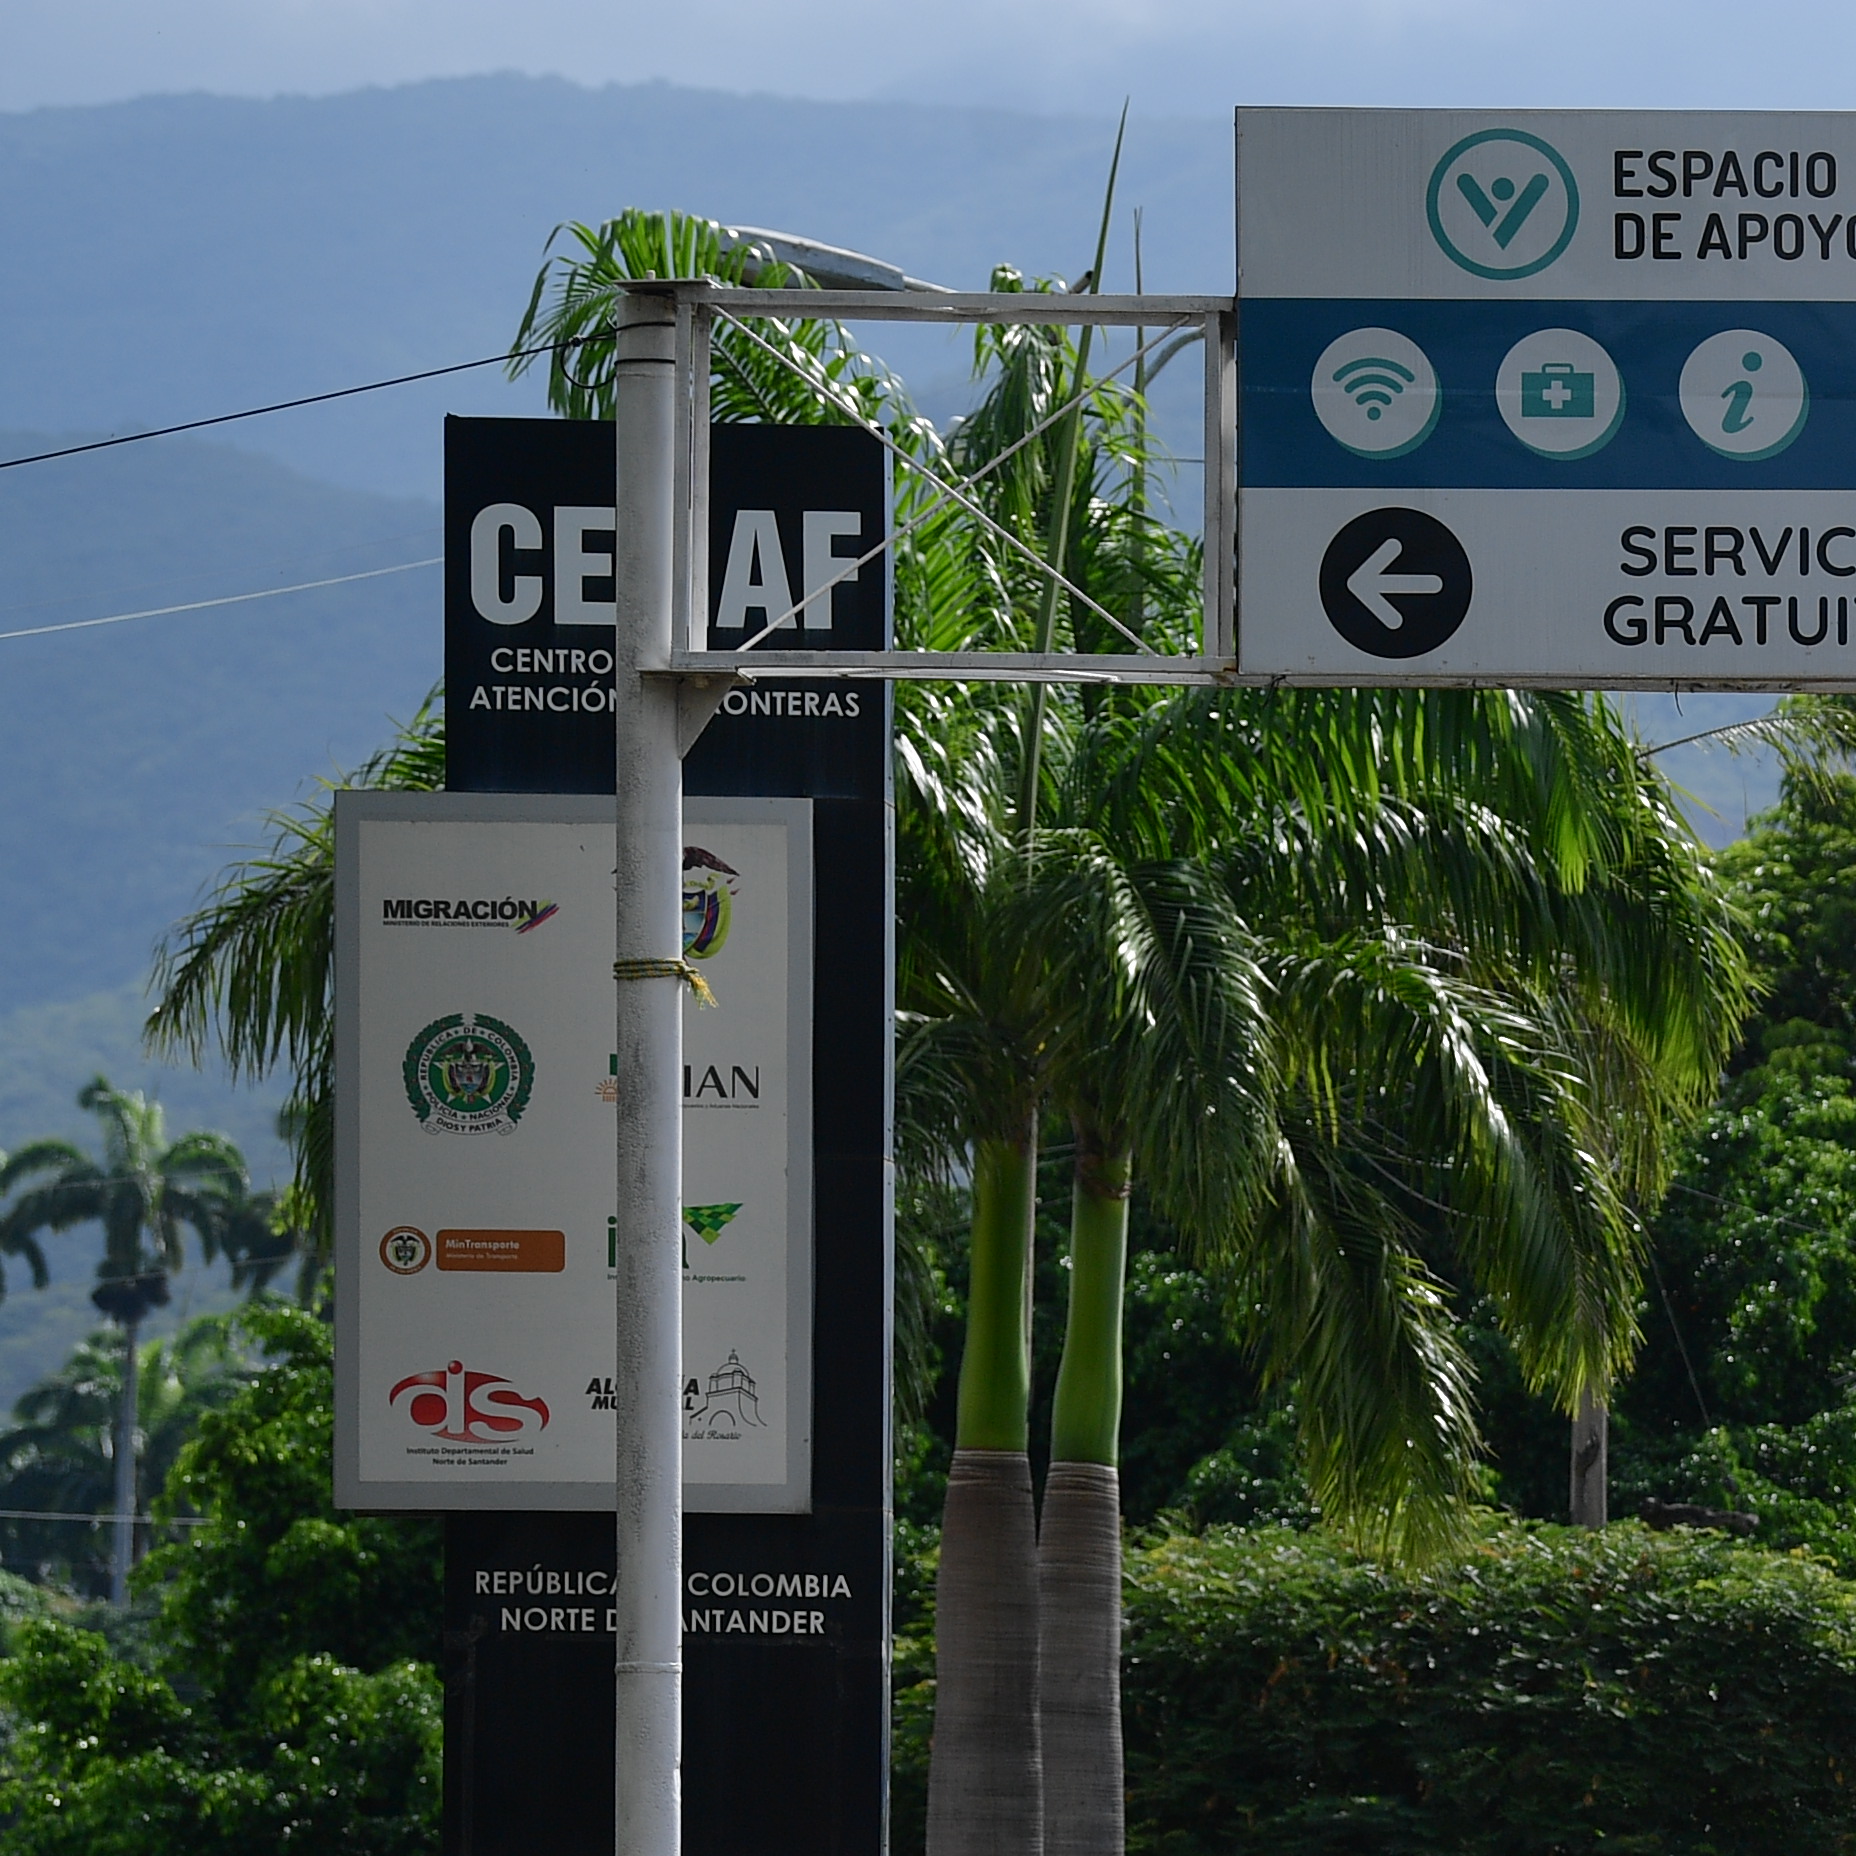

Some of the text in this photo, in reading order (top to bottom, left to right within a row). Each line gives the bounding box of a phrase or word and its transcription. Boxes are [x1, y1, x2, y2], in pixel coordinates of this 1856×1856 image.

[1614, 150, 1837, 198] ESPACIO
[1615, 213, 1682, 260] DE
[470, 502, 862, 631] CEAF
[490, 647, 613, 675] CENTRO
[383, 896, 537, 920] MIGRACIÓN
[487, 1033, 518, 1082] COLOMBIA
[684, 1065, 759, 1099] IAN
[469, 1091, 514, 1120] NACIONAL
[468, 1118, 503, 1132] PATRIA
[445, 1239, 520, 1251] MinTransporte
[406, 1447, 439, 1455] Instituto
[441, 1447, 498, 1456] Departamental
[468, 1458, 508, 1466] Santander
[688, 1571, 852, 1599] COLOMBIA
[501, 1607, 595, 1632] NORTE
